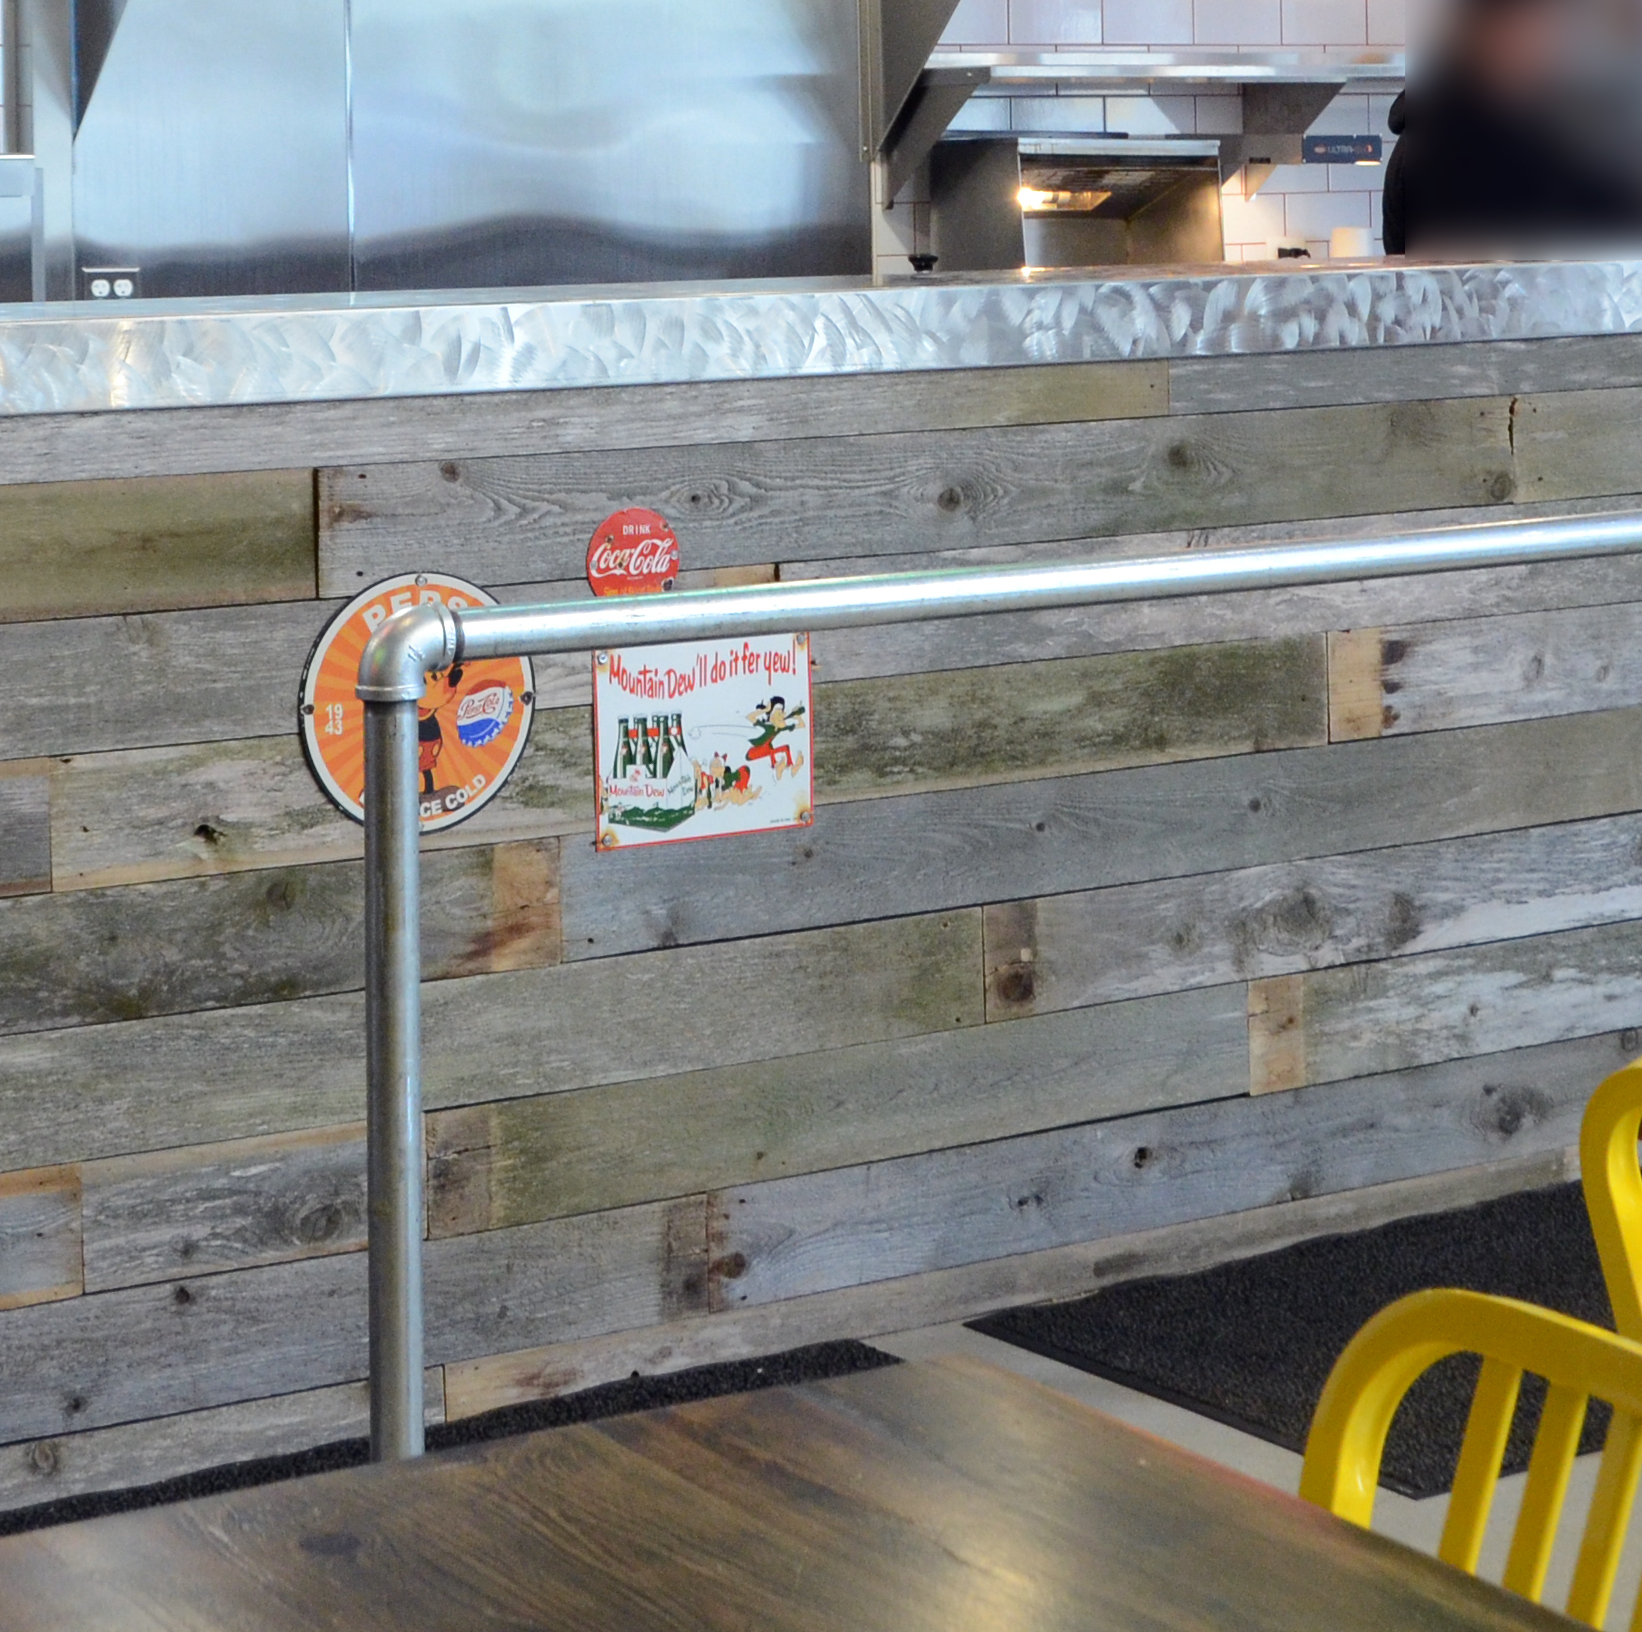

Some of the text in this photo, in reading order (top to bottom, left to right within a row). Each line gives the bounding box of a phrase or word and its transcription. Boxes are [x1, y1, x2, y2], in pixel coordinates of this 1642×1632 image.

[622, 524, 652, 536] DRINK
[608, 653, 665, 700] Mountain
[710, 651, 726, 684] do
[730, 648, 739, 678] it
[741, 641, 761, 675] fer
[764, 638, 797, 686] yew!
[325, 704, 343, 719] 19
[324, 720, 343, 735] 43
[445, 774, 487, 810] COLD
[609, 784, 644, 798] Mountain
